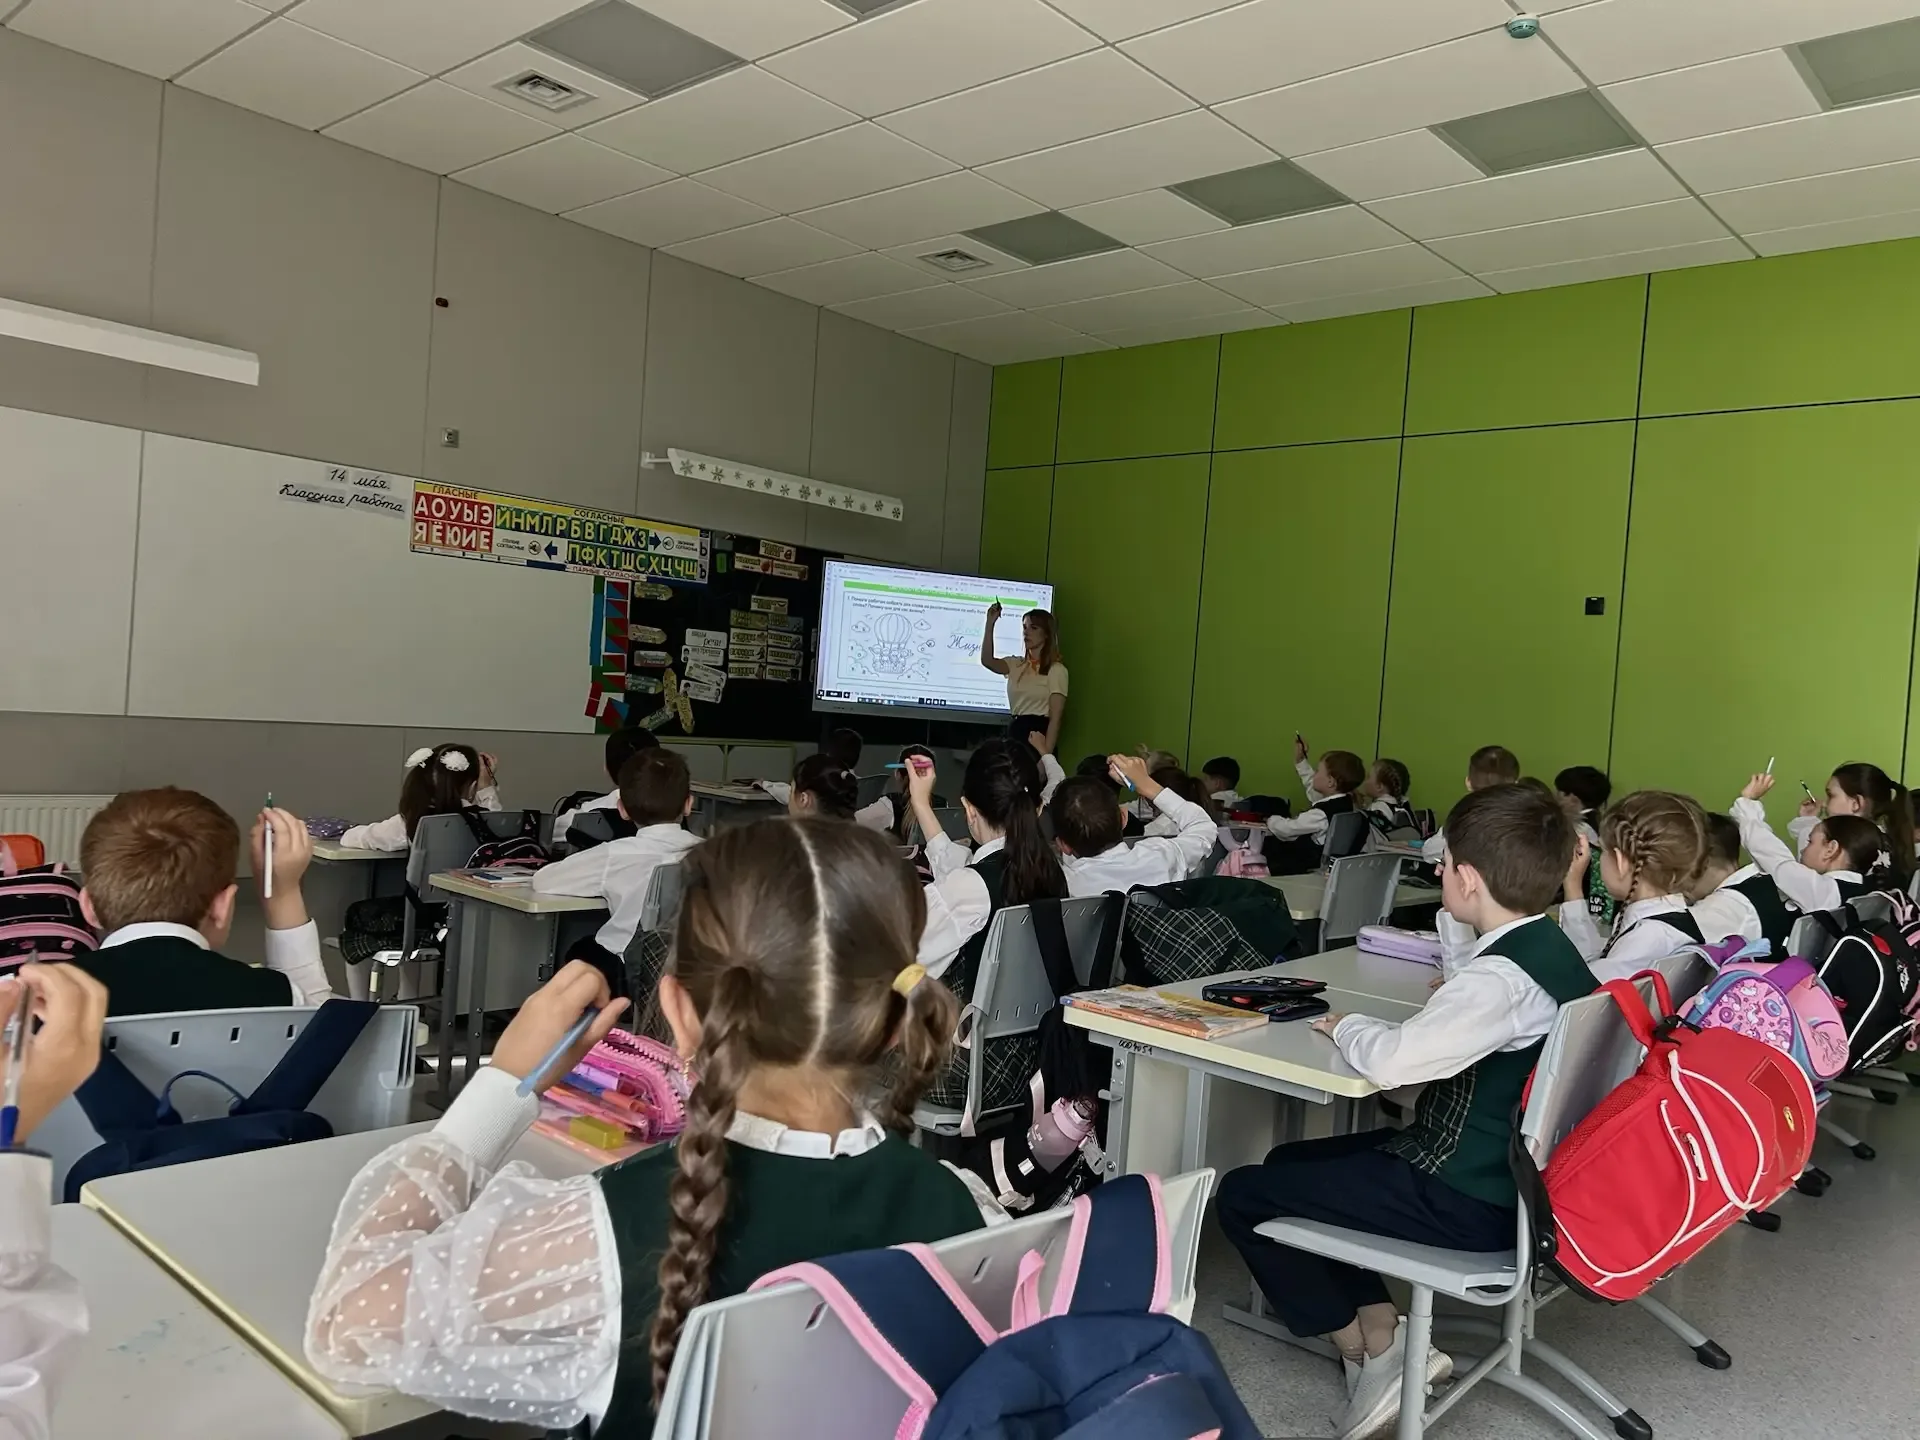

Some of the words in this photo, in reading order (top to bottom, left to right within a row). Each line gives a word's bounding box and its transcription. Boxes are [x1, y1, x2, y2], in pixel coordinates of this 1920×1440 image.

[330, 468, 346, 481] 14
[279, 483, 345, 504] Классная
[433, 485, 479, 500] ГЛАСНЫЕ
[574, 509, 625, 524] СОГЛАСНЫЕ
